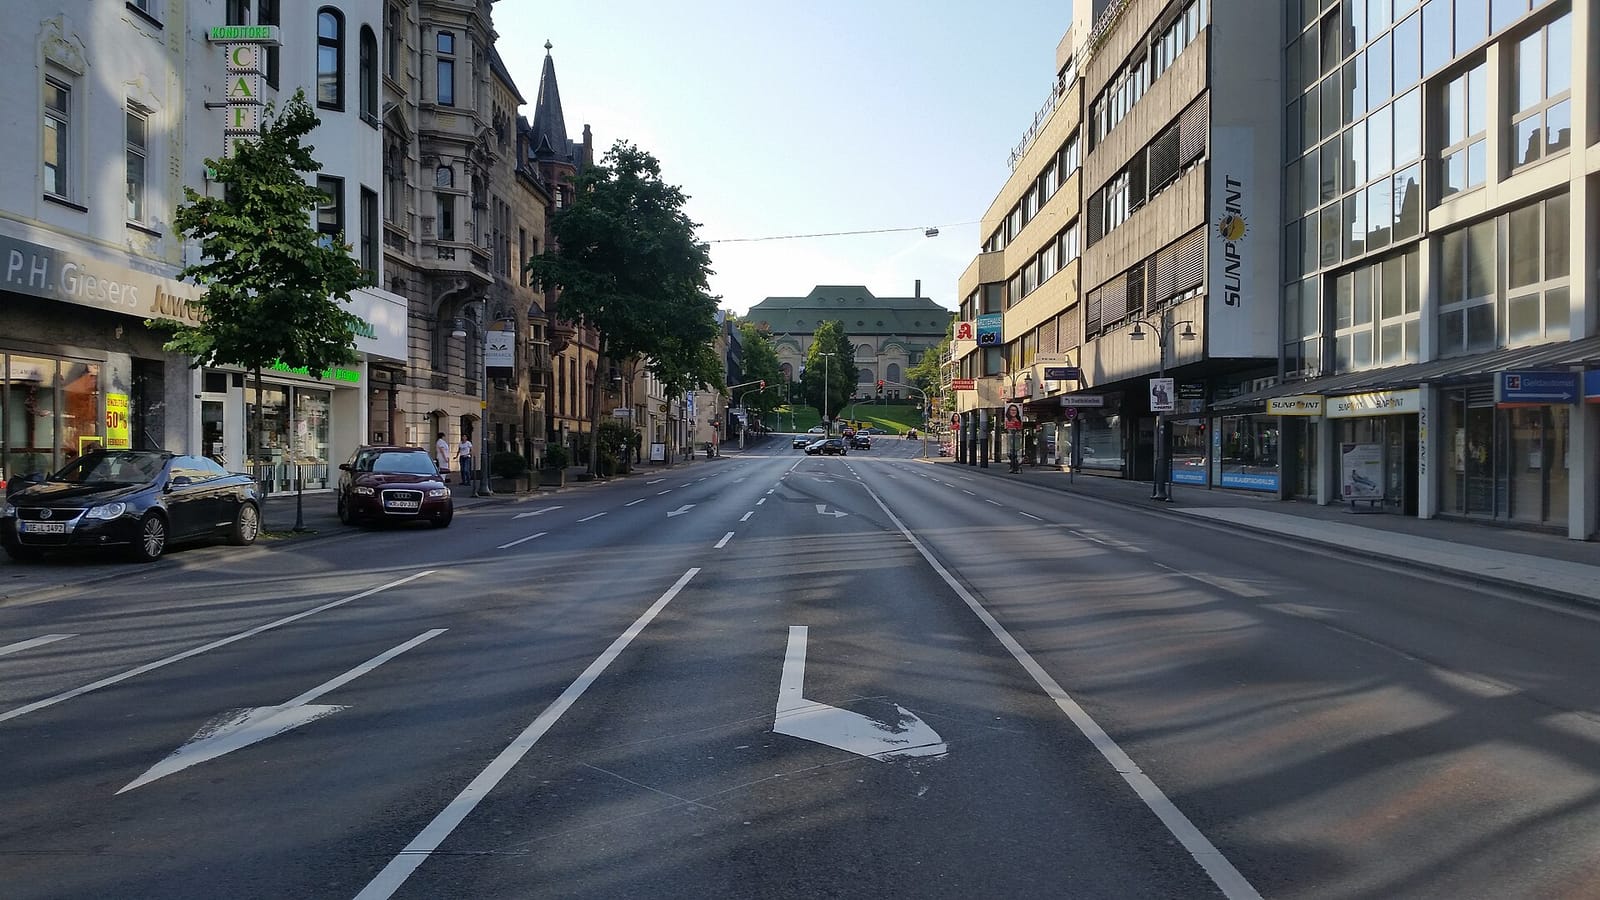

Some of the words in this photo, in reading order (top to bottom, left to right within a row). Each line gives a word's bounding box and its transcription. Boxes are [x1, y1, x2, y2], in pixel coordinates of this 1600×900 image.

[211, 26, 270, 38] KONDITOREI
[61, 261, 139, 308] Giesers
[106, 411, 128, 429] 50%
